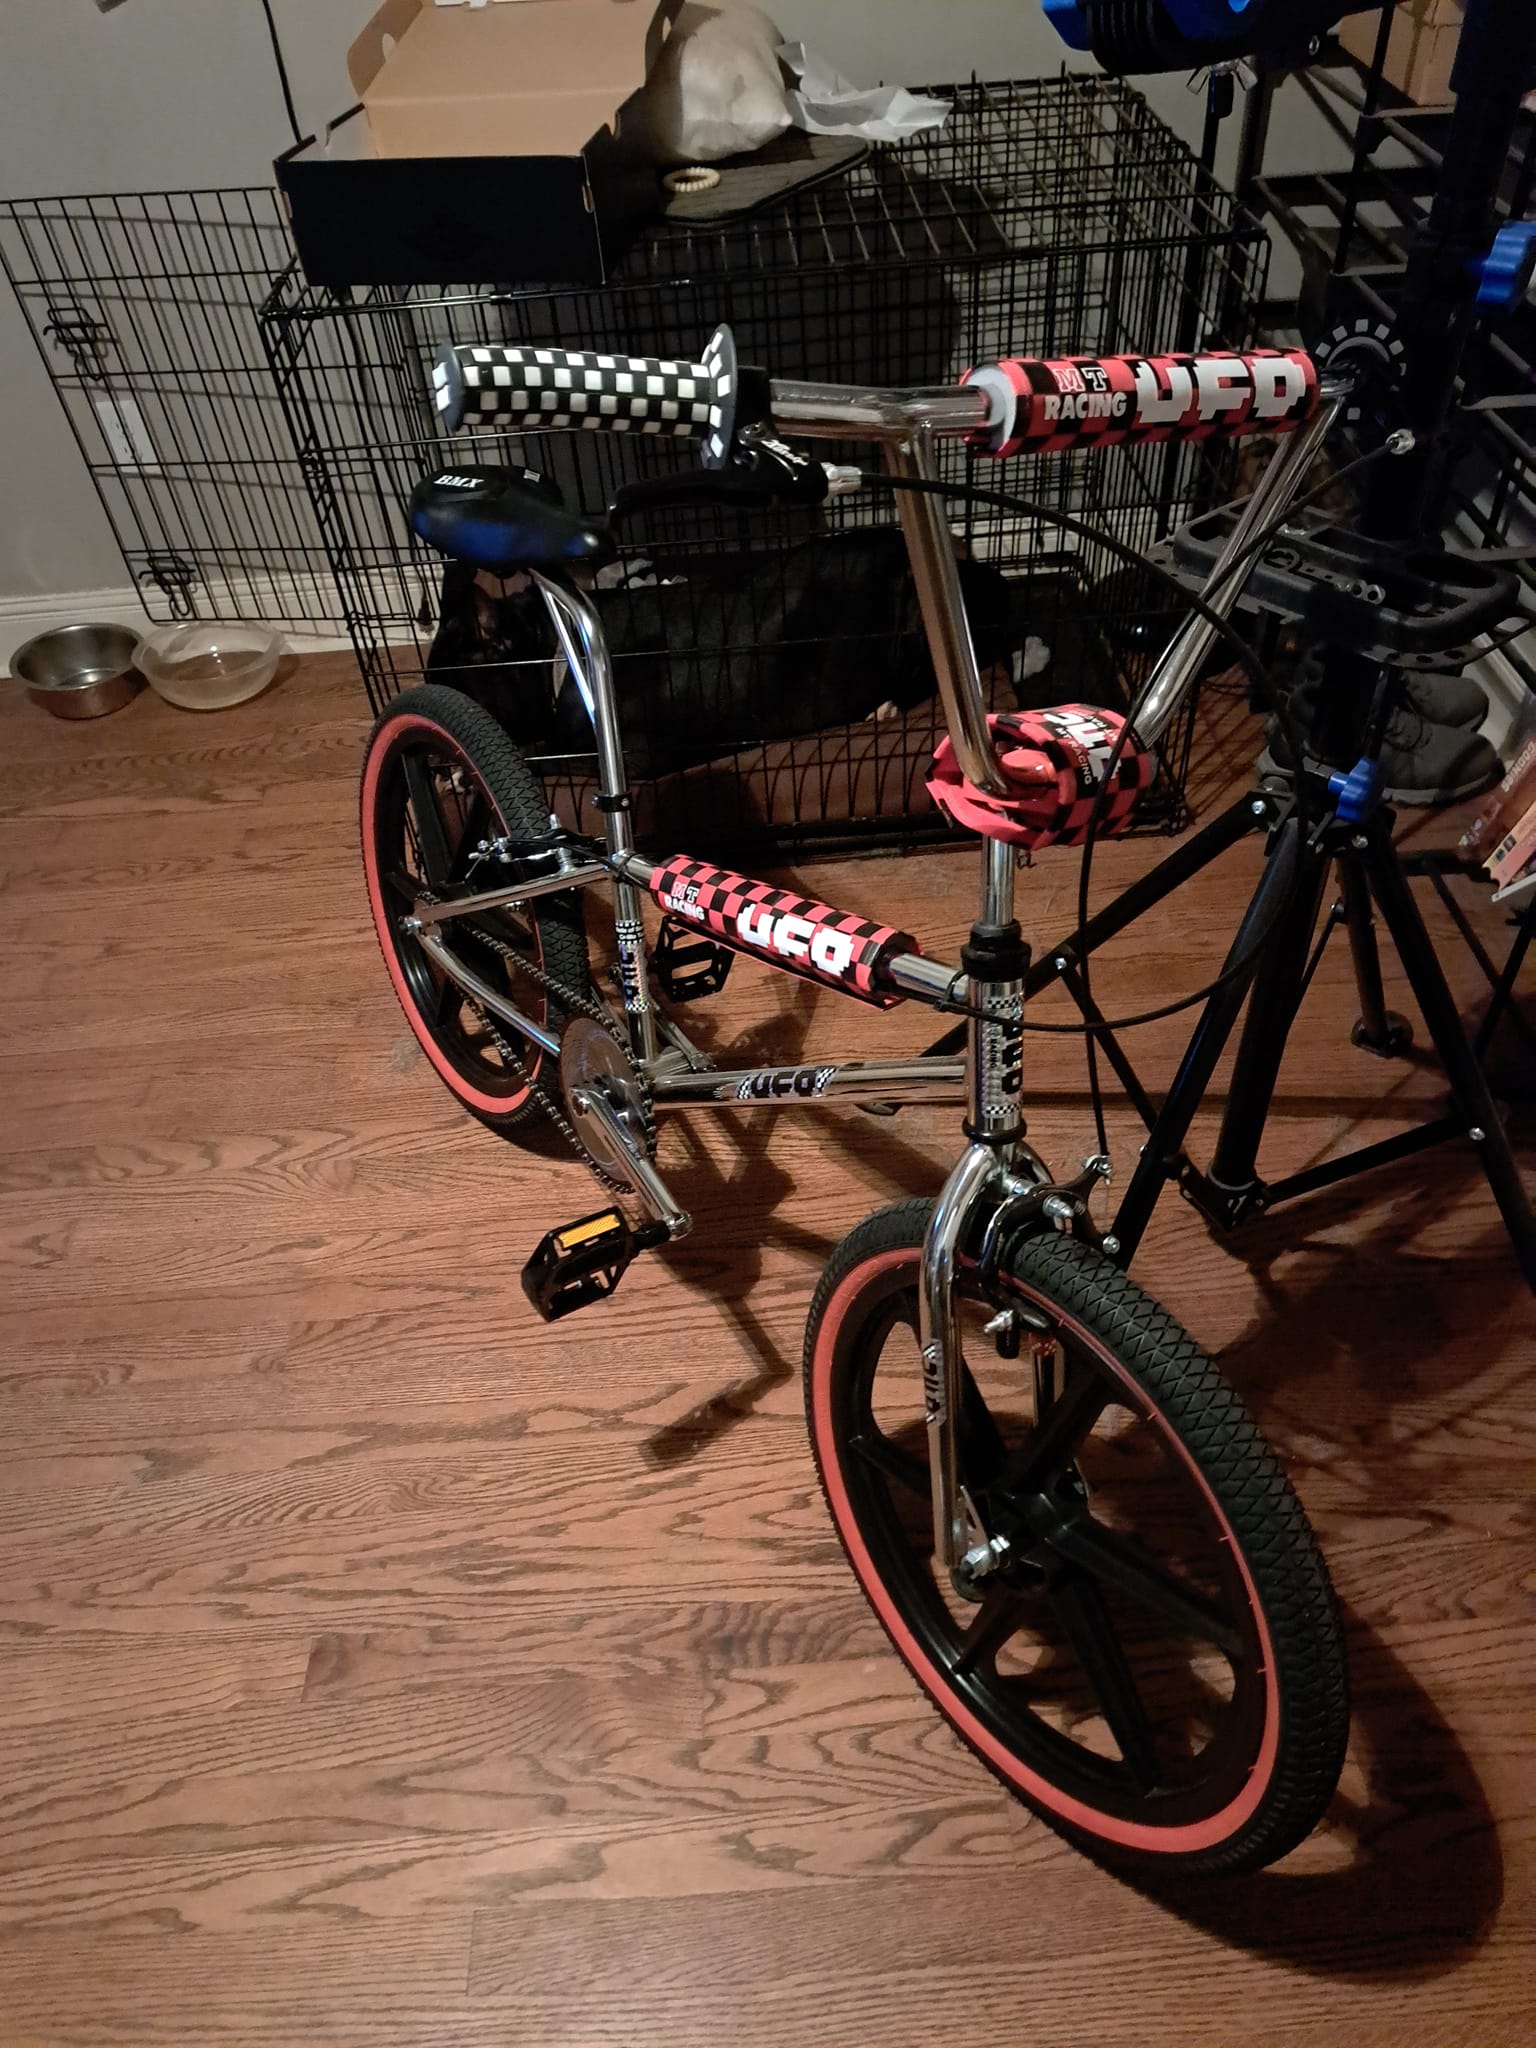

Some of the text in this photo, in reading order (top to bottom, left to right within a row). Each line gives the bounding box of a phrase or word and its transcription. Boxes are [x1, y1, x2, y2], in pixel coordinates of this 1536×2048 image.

[1052, 367, 1108, 393] MT
[1135, 357, 1307, 424] UFO
[1044, 392, 1128, 420] RACING
[434, 474, 485, 488] BMX
[1068, 739, 1093, 785] RACING
[671, 881, 701, 903] MT
[664, 895, 705, 920] RACING
[736, 903, 855, 977] UFO
[750, 1069, 817, 1099] UFO
